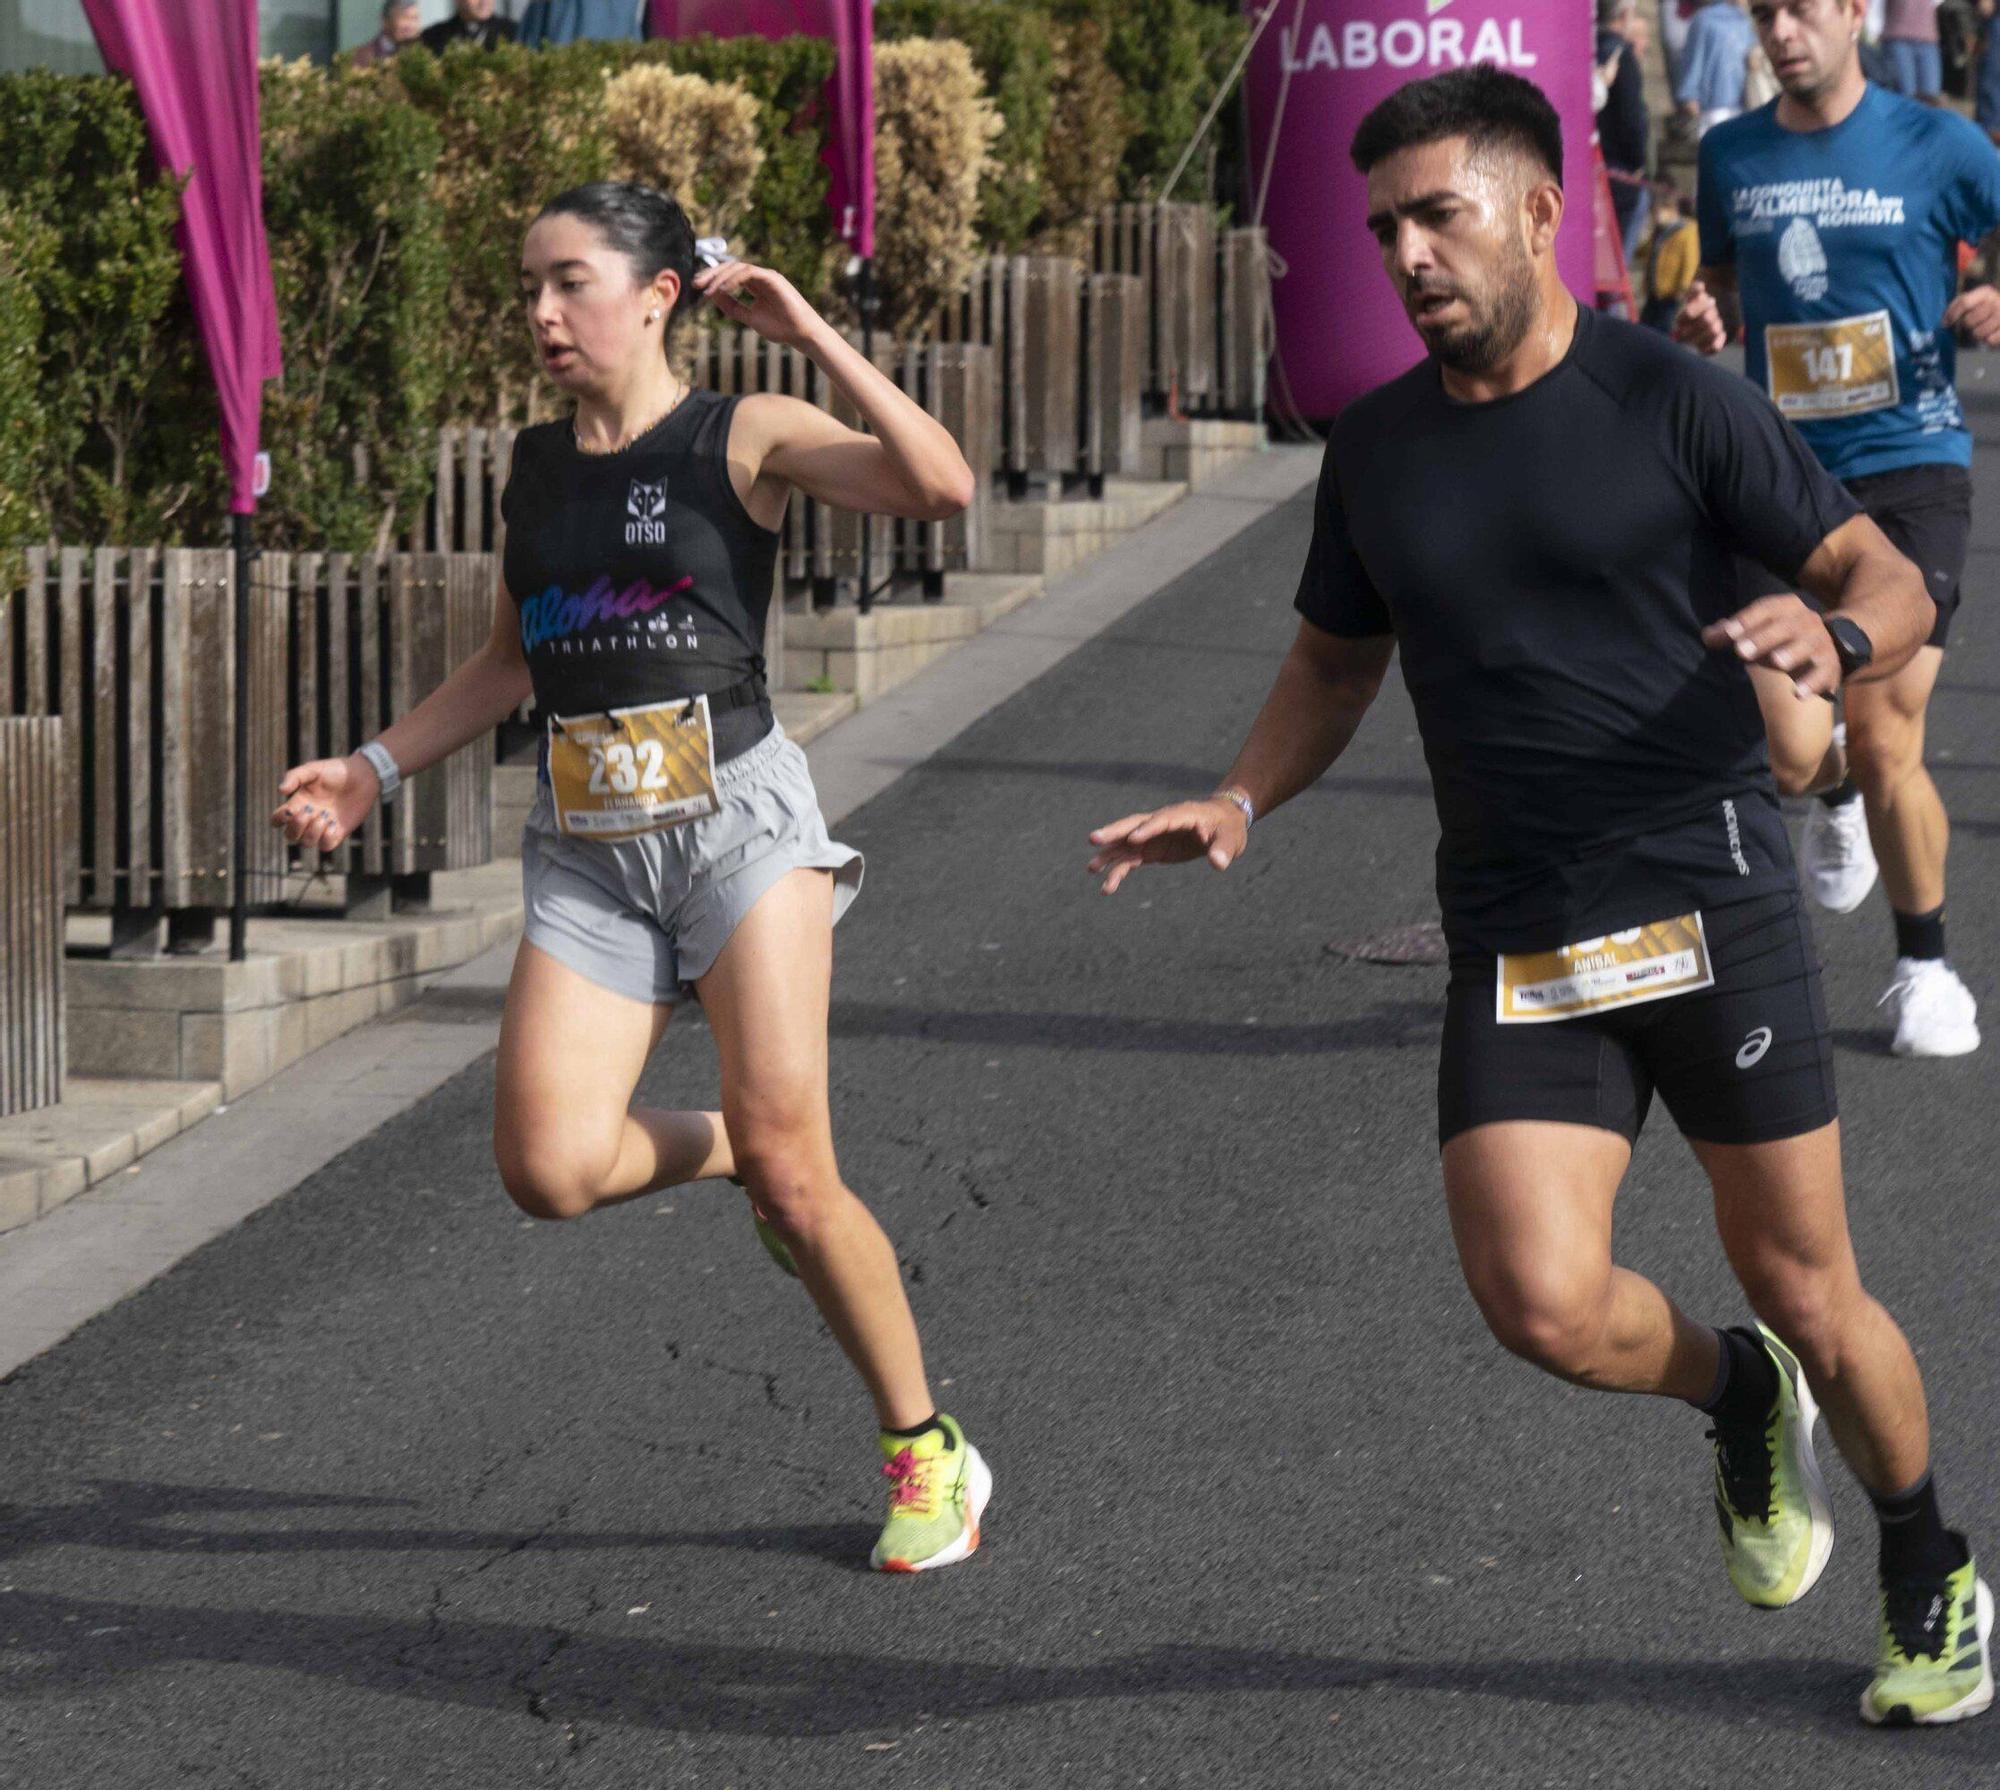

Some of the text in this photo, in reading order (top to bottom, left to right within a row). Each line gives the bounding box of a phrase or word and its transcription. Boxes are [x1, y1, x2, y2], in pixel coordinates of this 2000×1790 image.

[1279, 18, 1537, 71] LABORAL
[1752, 188, 1879, 219] ALMENDRA
[1817, 207, 1905, 228] KONKISTA
[1801, 342, 1853, 384] 147
[625, 520, 666, 544] OTSO
[550, 632, 698, 655] TRIATHLON
[588, 738, 669, 796] 232
[1722, 799, 1750, 876] SALOMON
